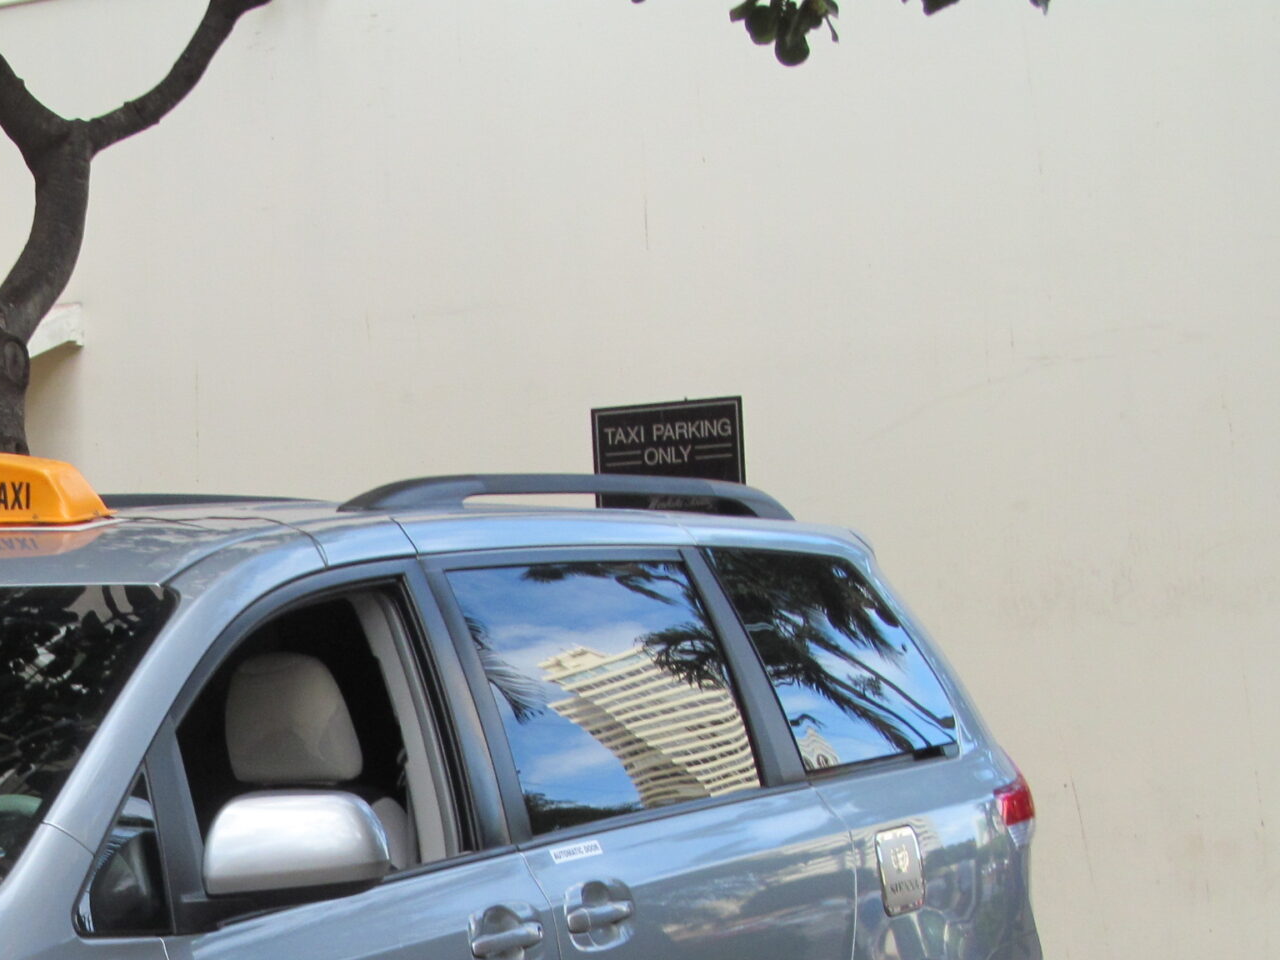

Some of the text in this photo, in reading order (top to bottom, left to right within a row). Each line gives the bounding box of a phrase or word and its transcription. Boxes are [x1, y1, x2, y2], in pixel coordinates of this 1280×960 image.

[603, 418, 732, 445] TAXI PARKING
[644, 445, 692, 465] ONLY
